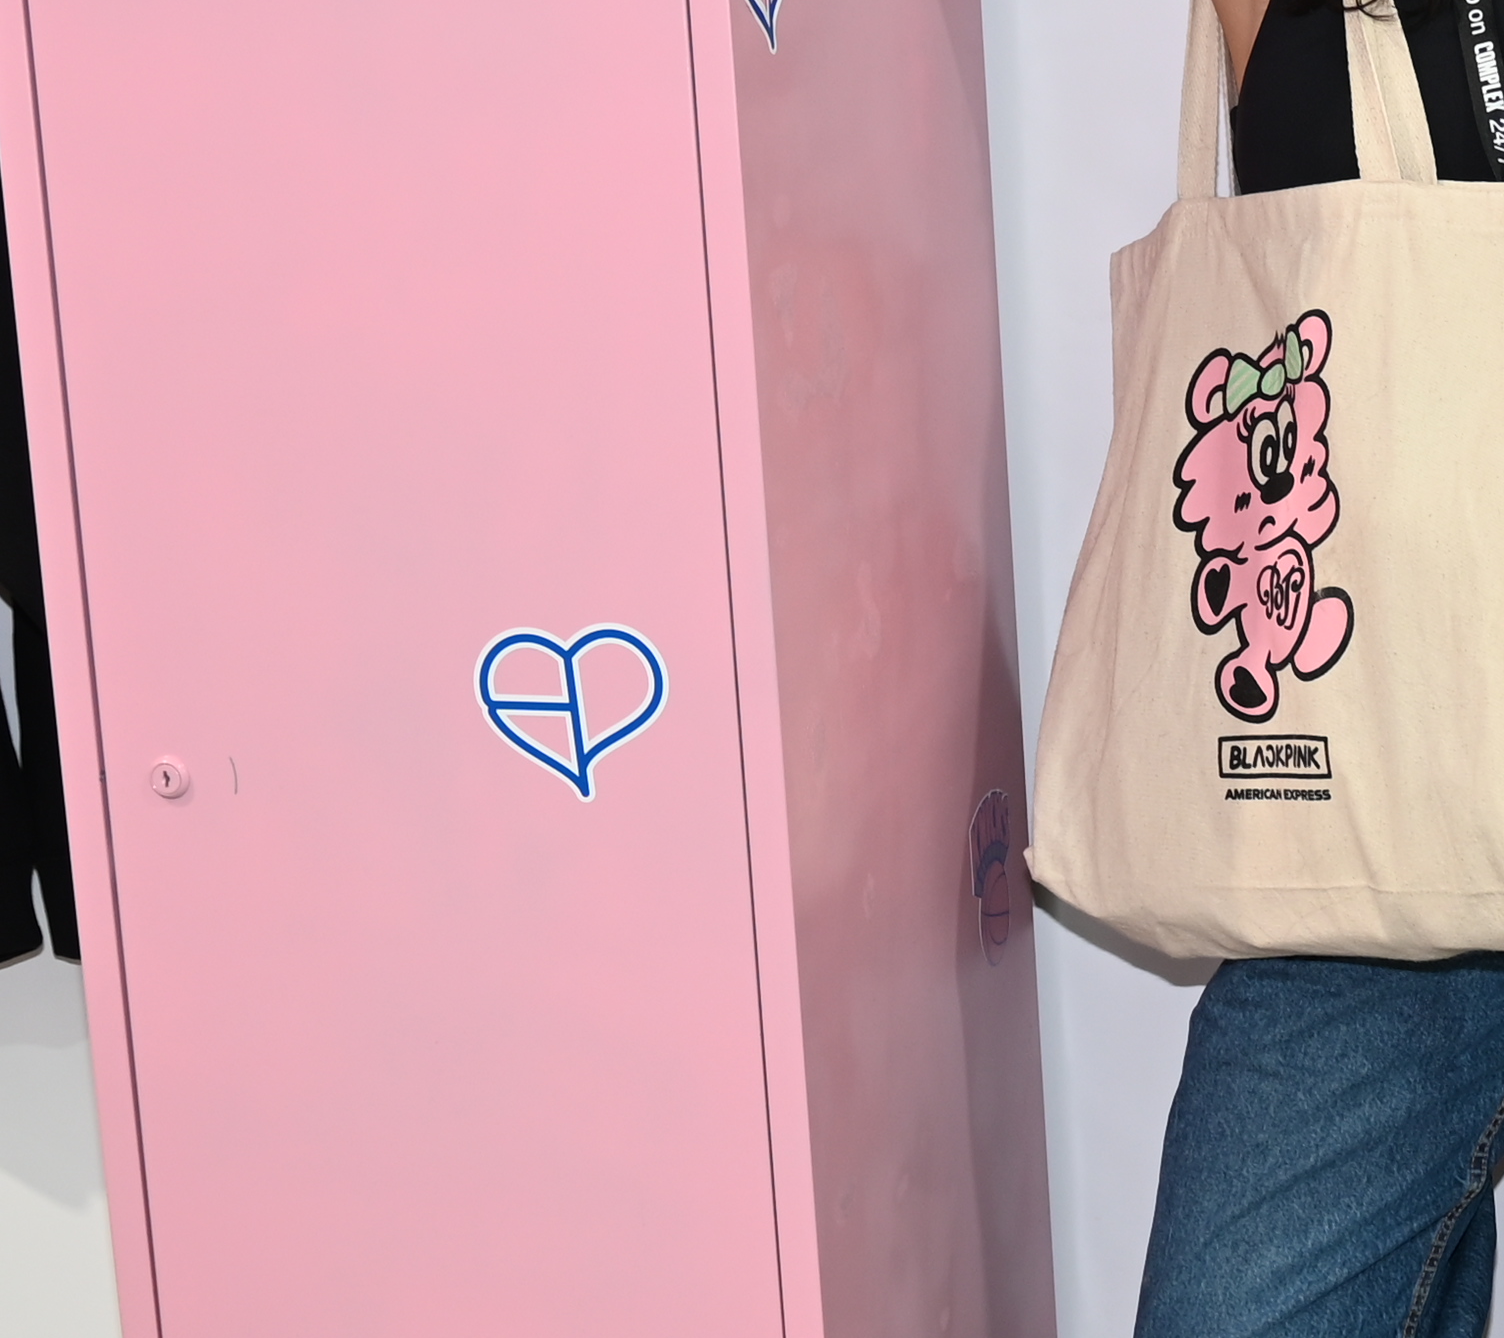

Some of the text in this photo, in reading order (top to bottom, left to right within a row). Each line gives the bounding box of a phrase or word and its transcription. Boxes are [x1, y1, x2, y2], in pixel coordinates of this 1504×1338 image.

[1468, 8, 1487, 36] on
[1229, 744, 1321, 770] BLACKPINK
[1225, 789, 1332, 801] AMERICAN EXPRESS
